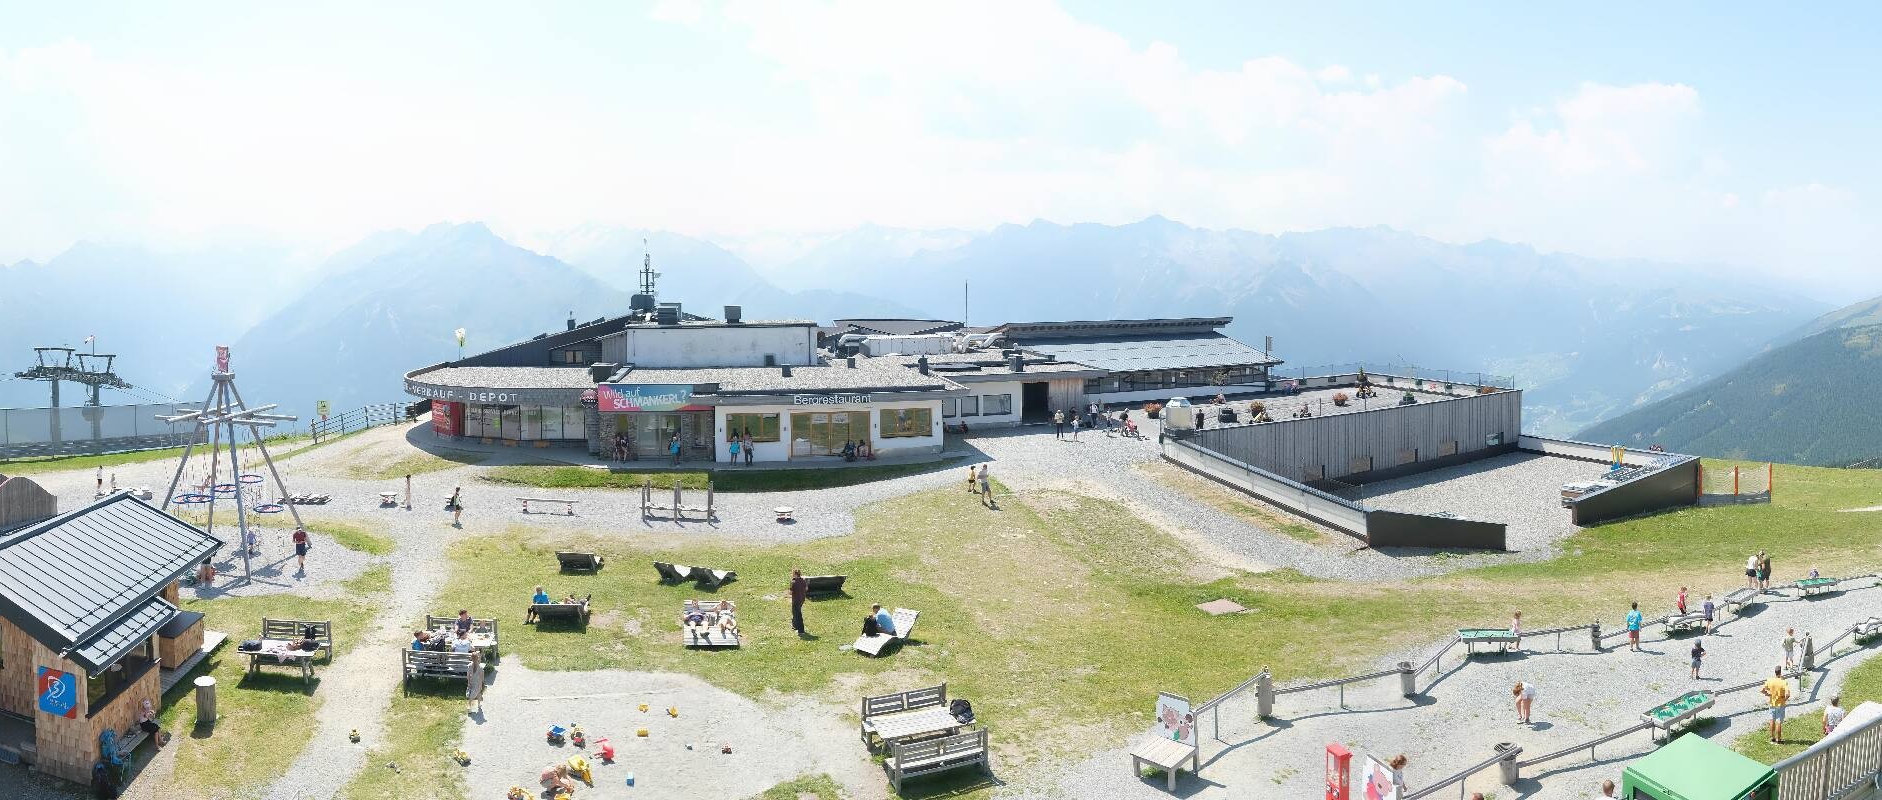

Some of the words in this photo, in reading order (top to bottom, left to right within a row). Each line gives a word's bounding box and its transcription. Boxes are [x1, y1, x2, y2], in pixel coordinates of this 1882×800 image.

[412, 385, 454, 399] VERKAUF
[469, 392, 518, 402] DEPOT
[603, 389, 624, 400] Wild
[625, 386, 641, 397] auf
[613, 389, 687, 409] SCHMANKERL?
[793, 394, 872, 405] Bergrestaurant
